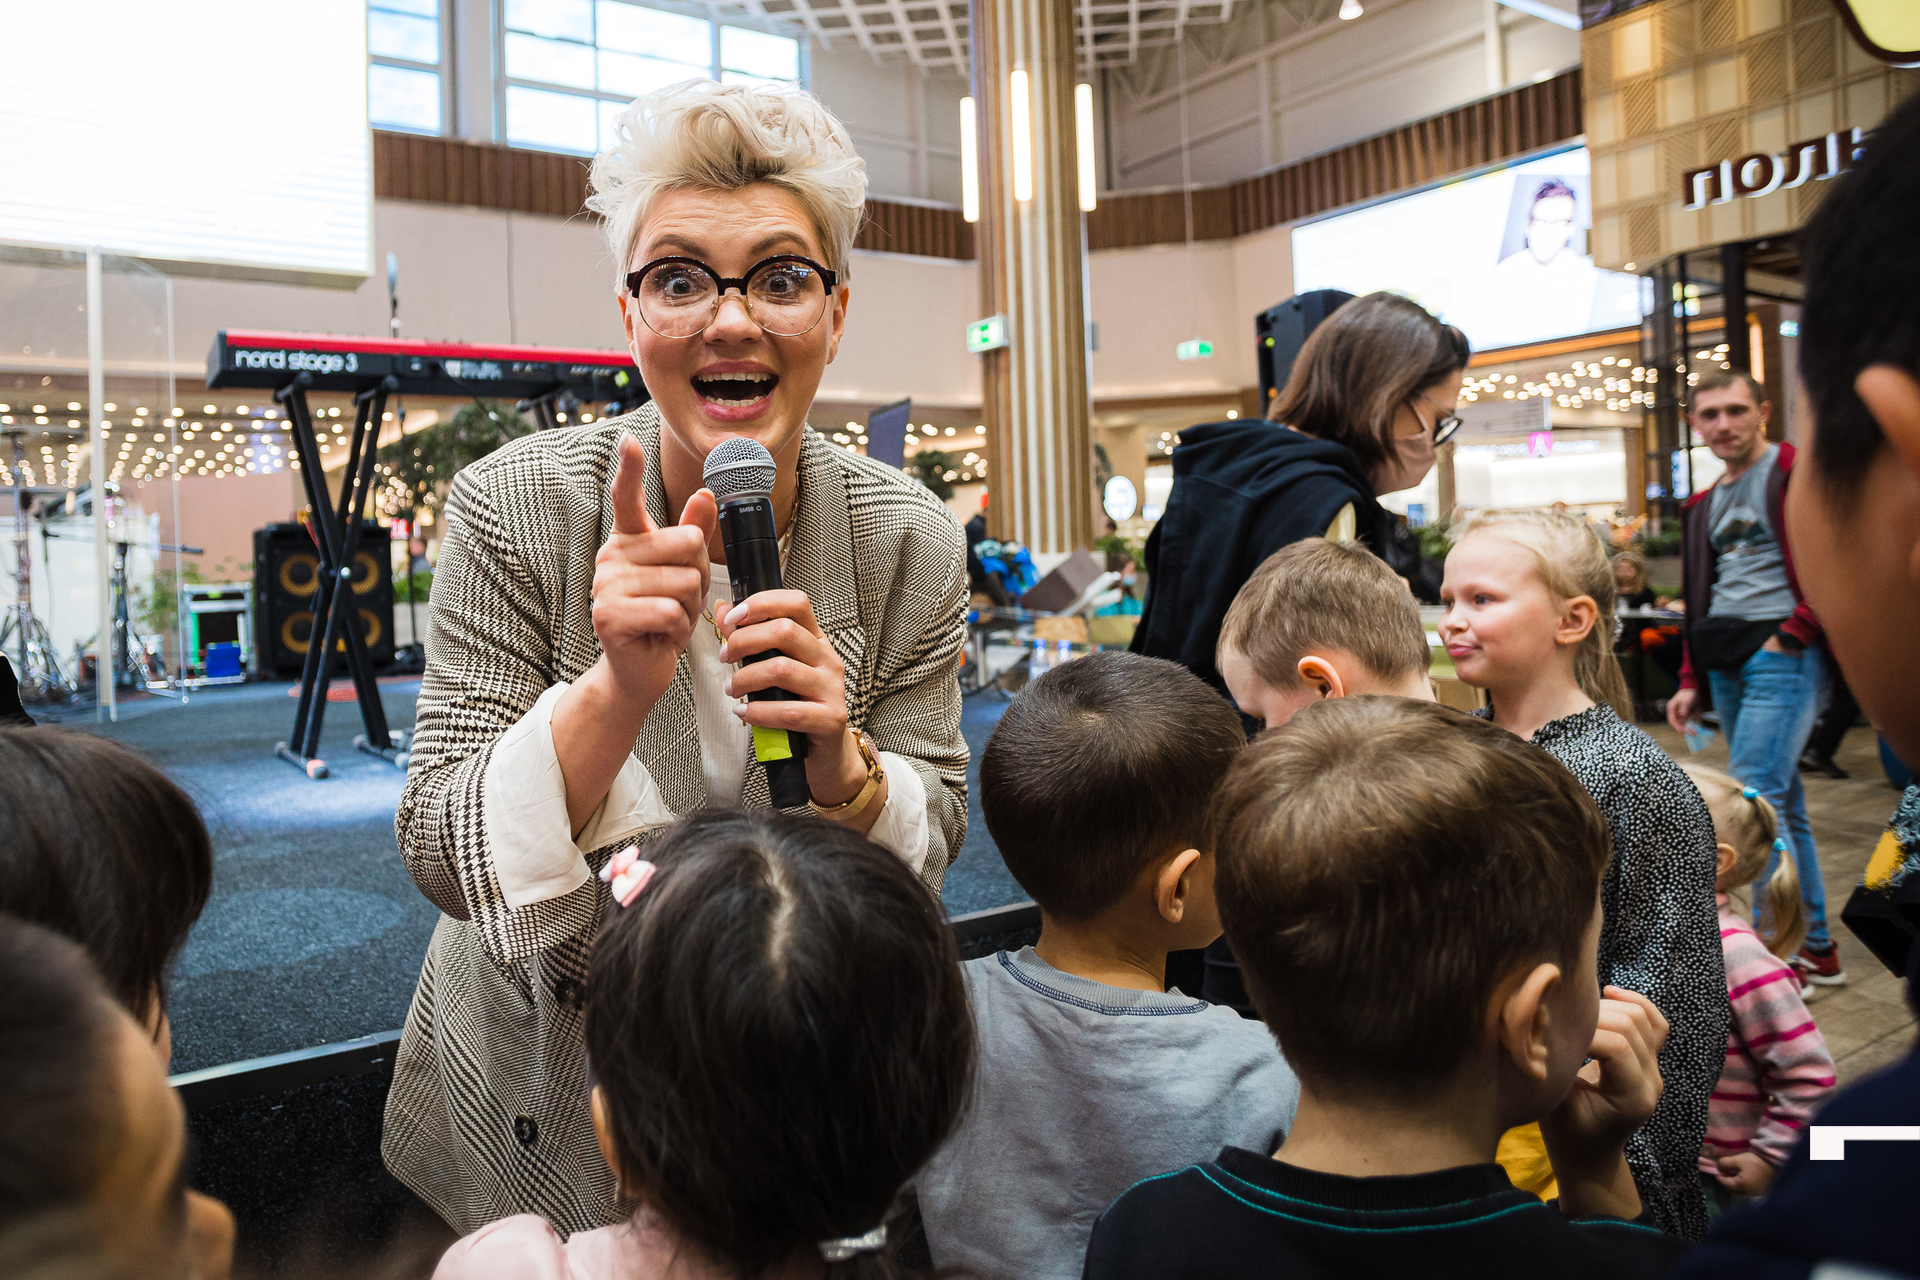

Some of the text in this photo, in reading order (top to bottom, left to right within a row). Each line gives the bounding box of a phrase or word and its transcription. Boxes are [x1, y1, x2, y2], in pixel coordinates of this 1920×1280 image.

[235, 350, 358, 374] nord stage 3
